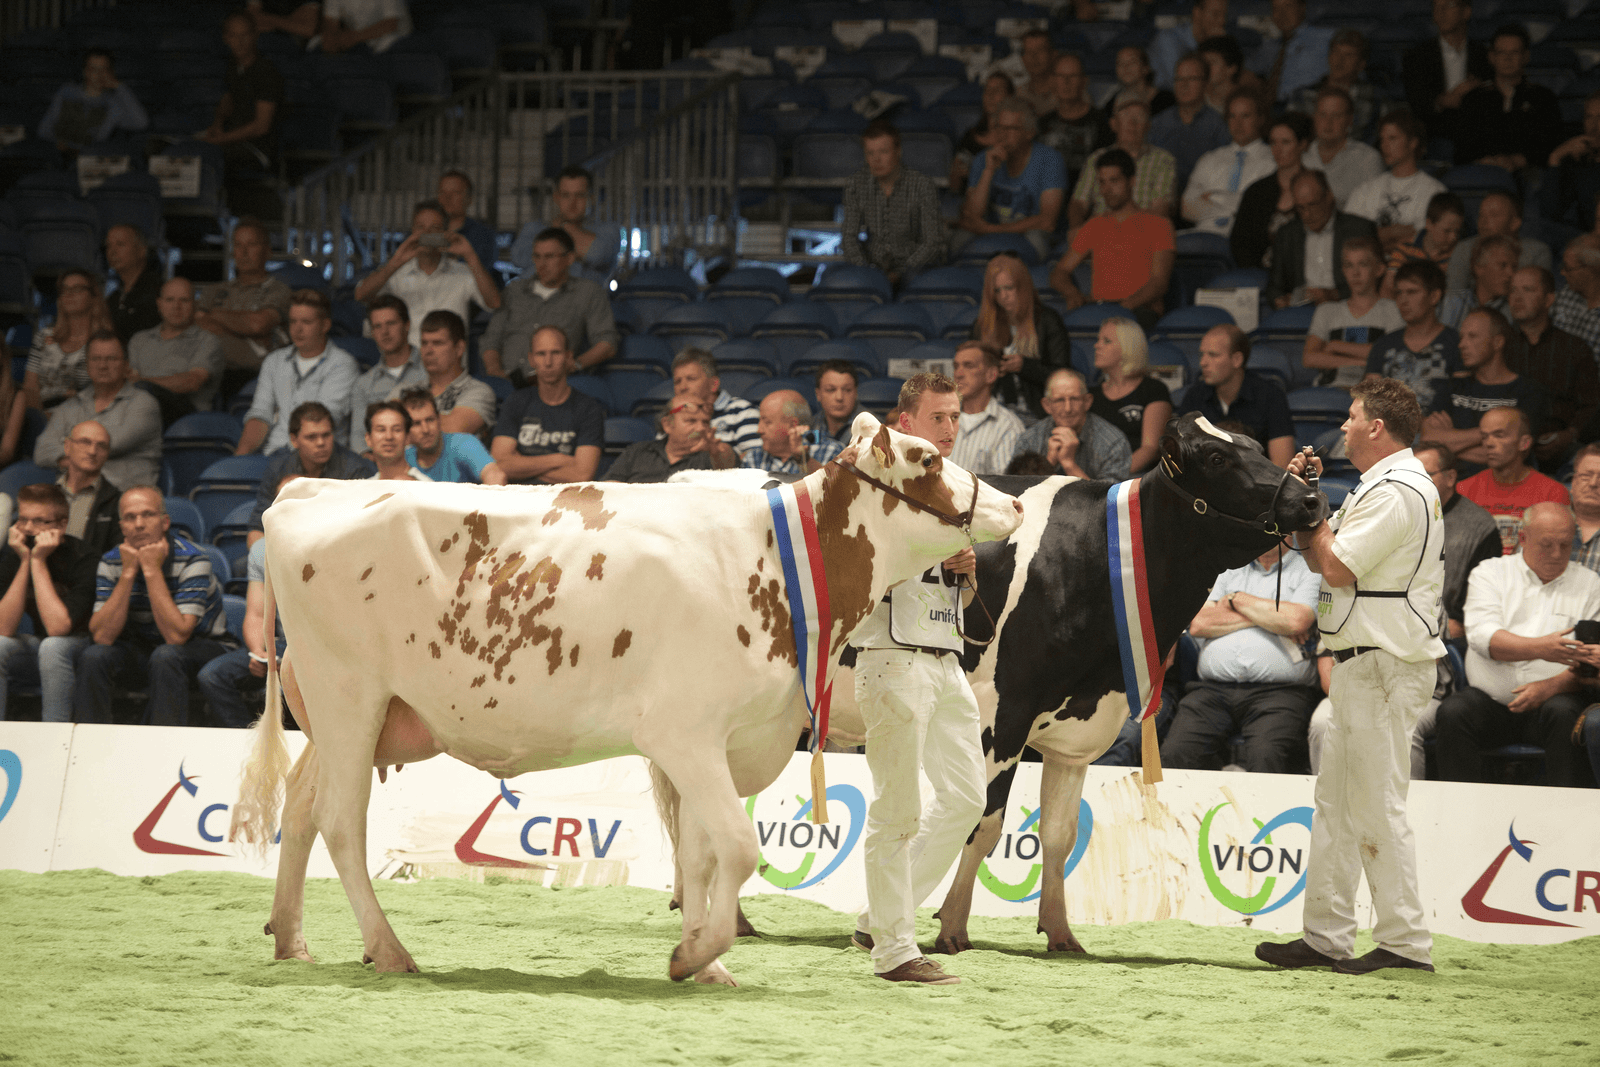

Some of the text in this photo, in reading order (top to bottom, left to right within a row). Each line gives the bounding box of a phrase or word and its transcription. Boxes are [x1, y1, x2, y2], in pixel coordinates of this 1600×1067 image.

[197, 803, 281, 844] CR
[520, 816, 622, 858] CRV
[757, 821, 841, 850] VION
[986, 833, 1040, 860] IO
[1213, 844, 1302, 875] VION
[1535, 868, 1600, 914] CR
